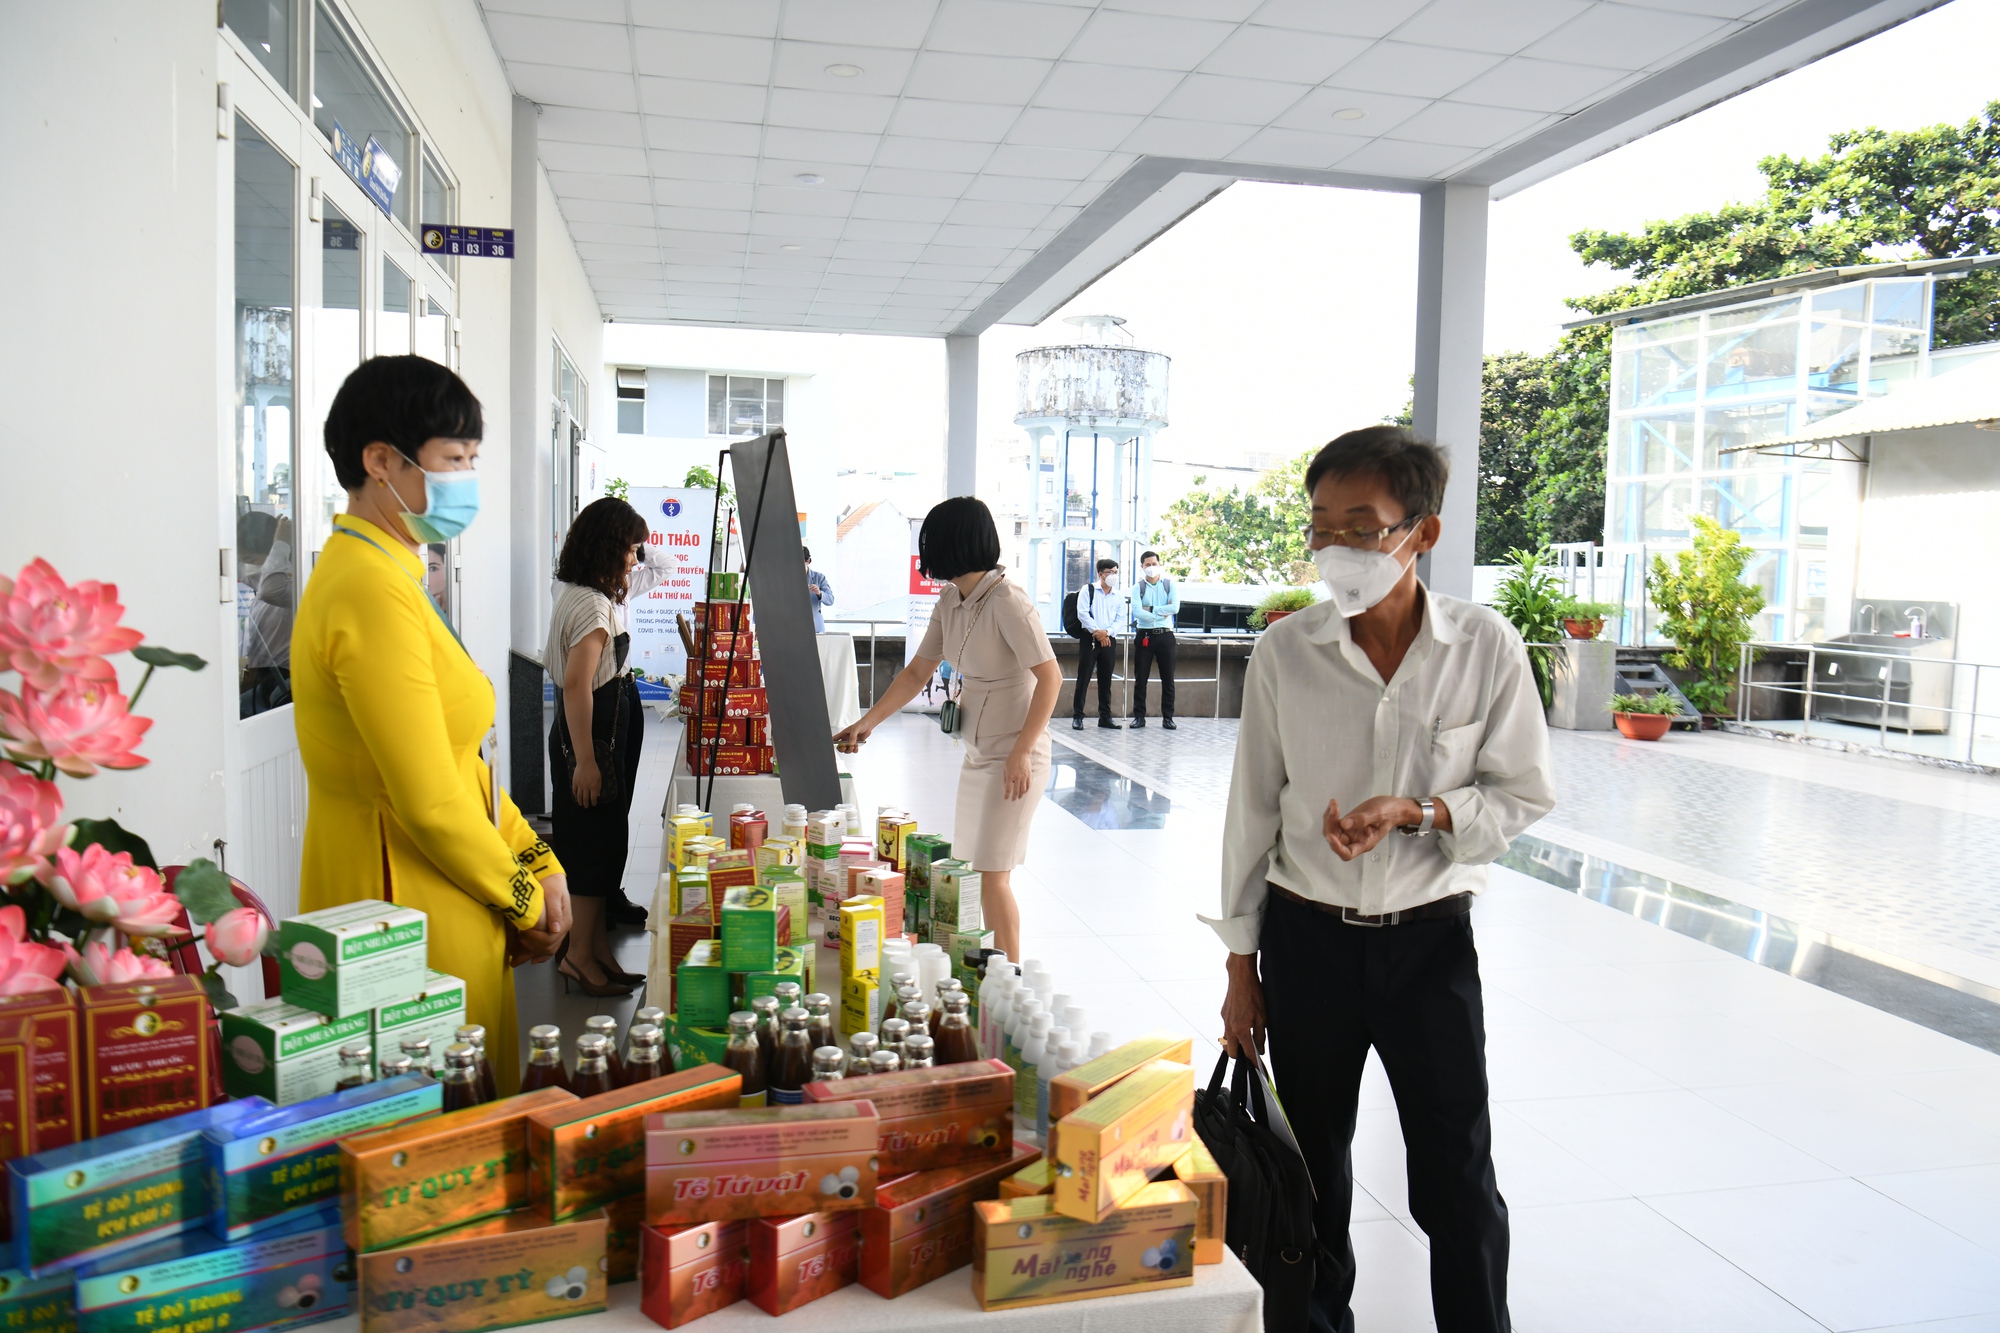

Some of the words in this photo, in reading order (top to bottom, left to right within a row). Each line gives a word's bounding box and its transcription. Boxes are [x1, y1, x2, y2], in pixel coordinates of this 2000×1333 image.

[452, 242, 459, 253] B
[467, 243, 479, 254] 03
[492, 244, 504, 256] 36
[667, 530, 700, 547] THẢO
[671, 578, 691, 588] QUỐC
[664, 590, 679, 600] THỨ
[680, 592, 692, 600] HAI
[393, 925, 422, 943] TRÀNG
[431, 992, 460, 1011] TRÀNG
[335, 1015, 366, 1035] TRÀNG
[420, 1164, 476, 1198] QUY
[713, 1173, 752, 1198] Tứ
[754, 1169, 810, 1196] vật
[426, 1277, 488, 1307] QUY
